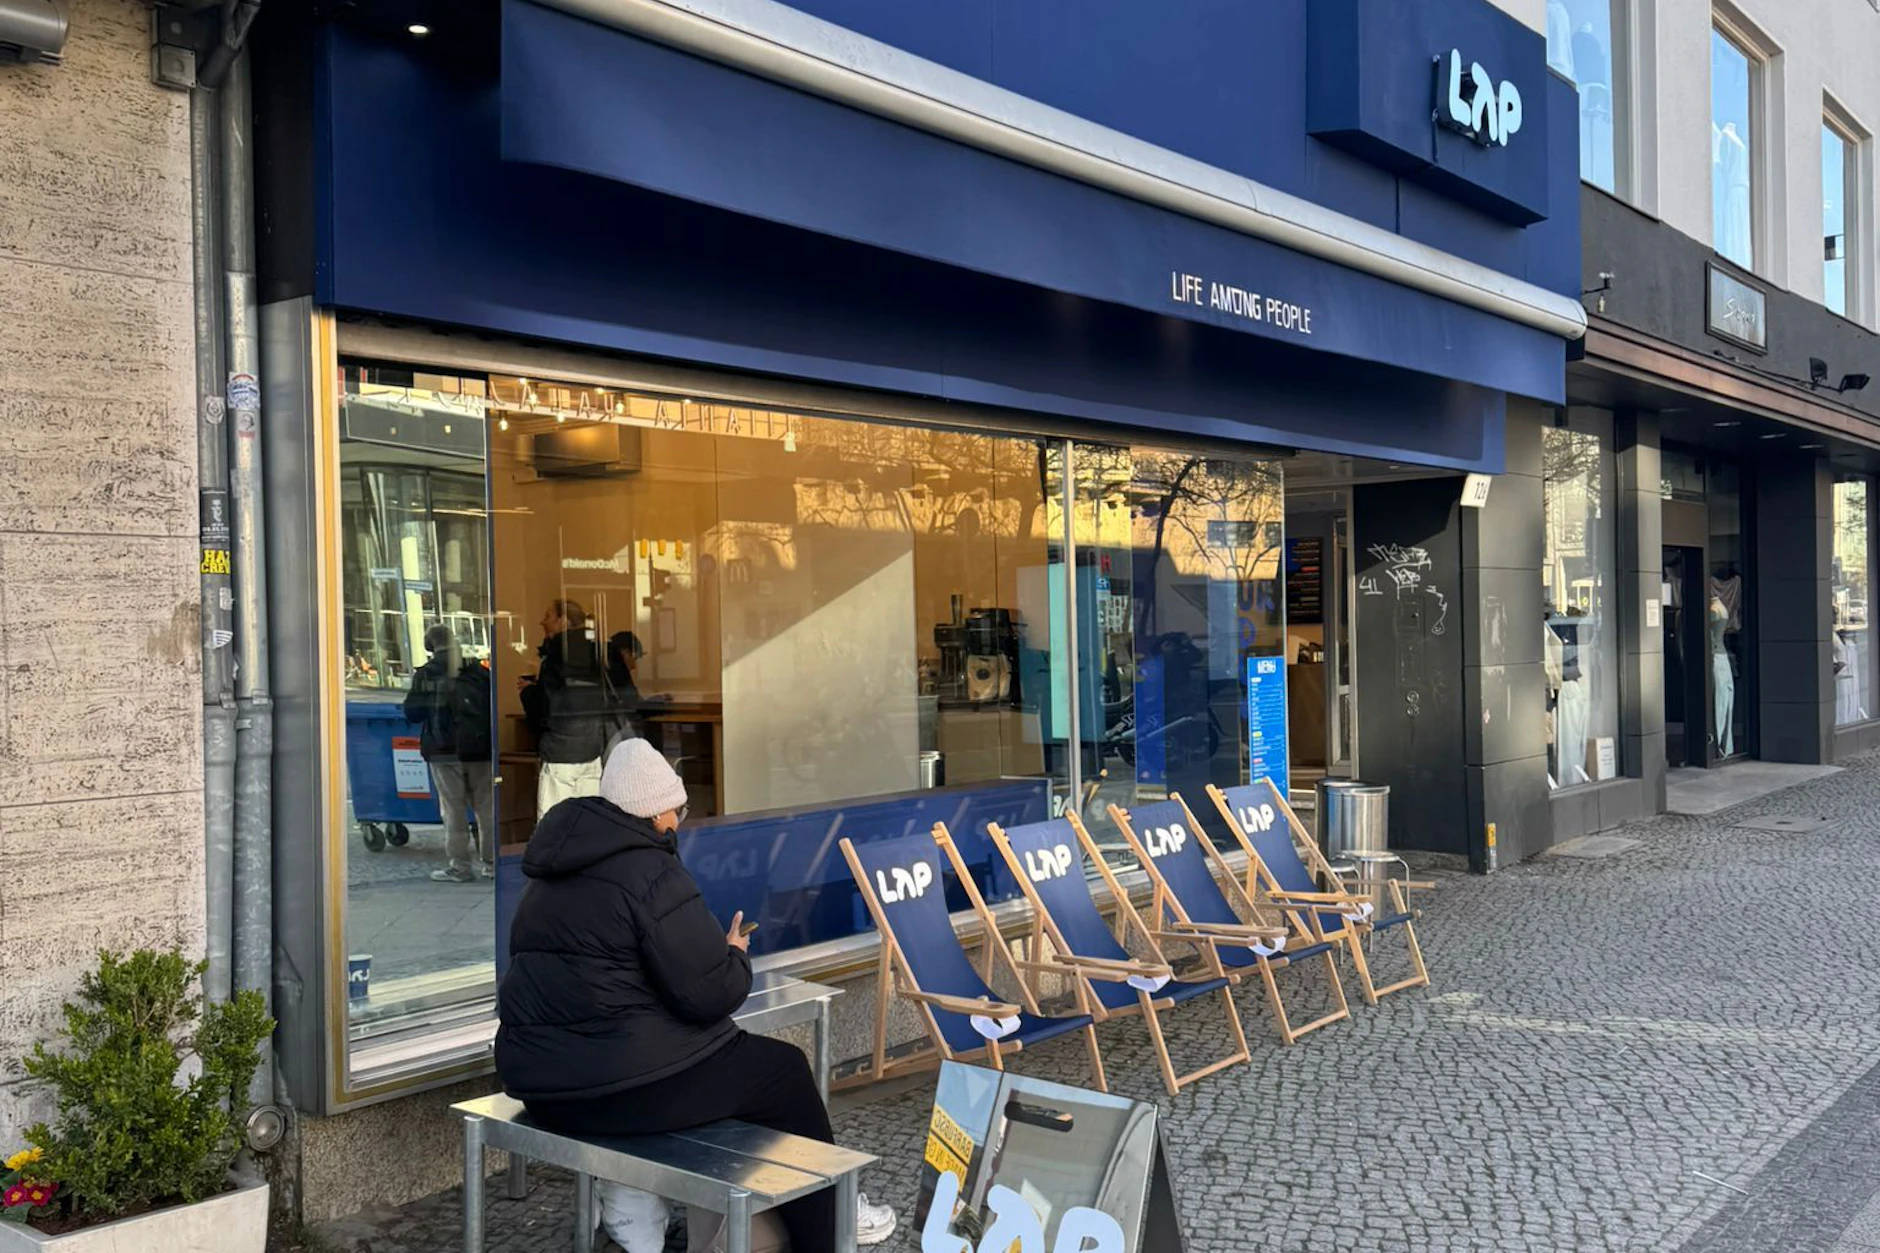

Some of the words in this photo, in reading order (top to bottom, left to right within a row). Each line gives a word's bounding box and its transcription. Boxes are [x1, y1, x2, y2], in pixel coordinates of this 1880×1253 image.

[1449, 48, 1522, 147] LAP
[1172, 271, 1203, 306] LIFE
[1210, 281, 1262, 321] AMONG
[1266, 297, 1312, 334] PEOPLE
[1239, 803, 1275, 833] LAP
[1145, 823, 1186, 857] LAP
[876, 861, 933, 904] LAP
[1025, 844, 1072, 882] LAP
